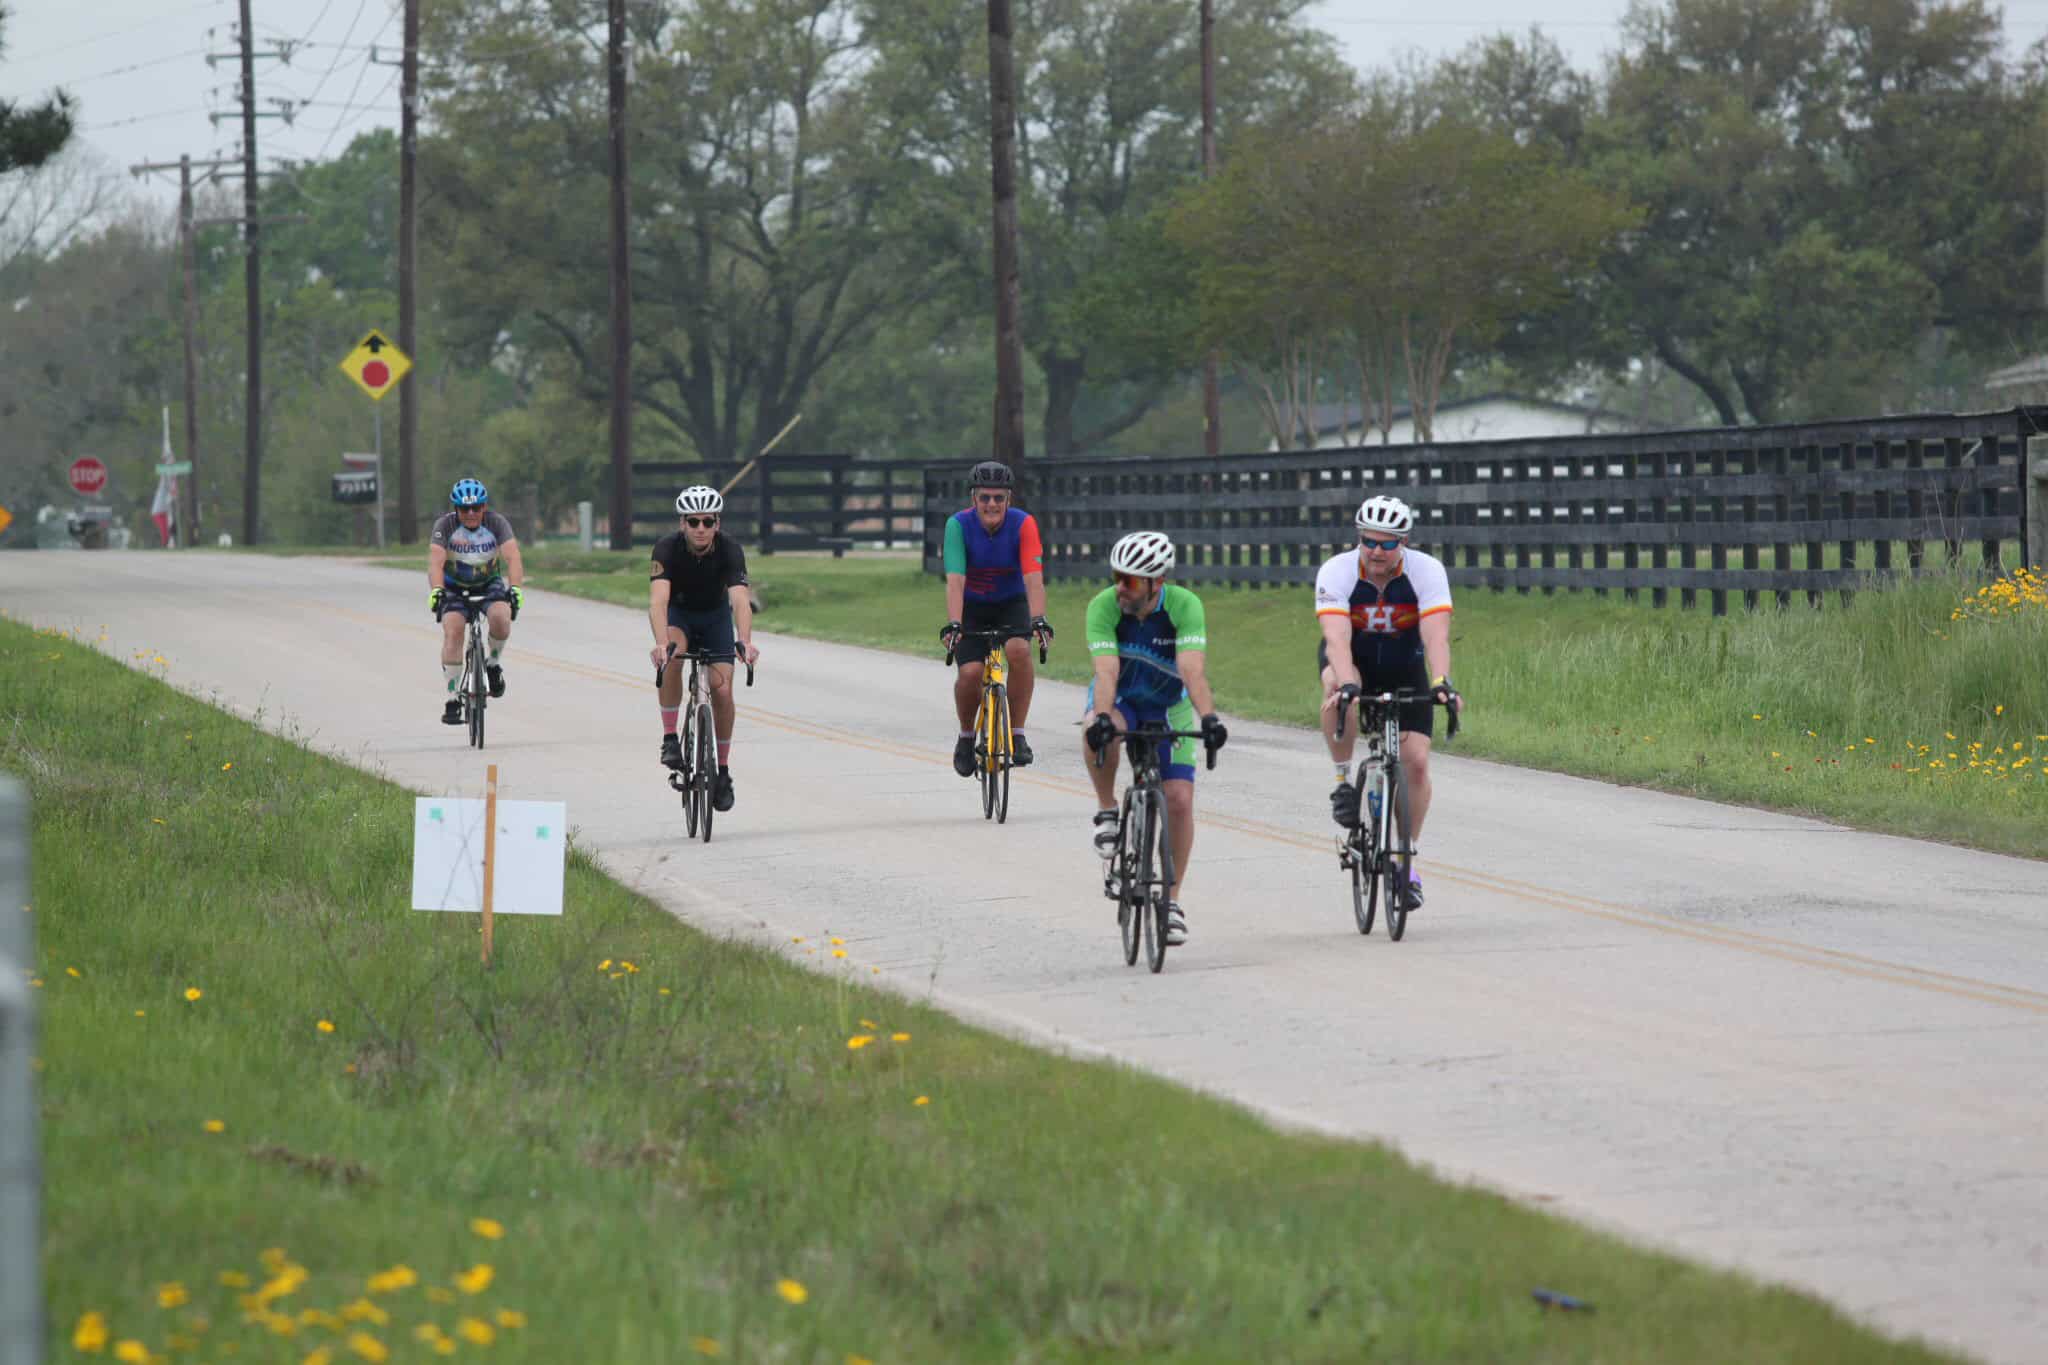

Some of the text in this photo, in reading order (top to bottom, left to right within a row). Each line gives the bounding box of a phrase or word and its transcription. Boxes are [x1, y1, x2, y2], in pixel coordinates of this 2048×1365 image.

[72, 468, 105, 482] STOP
[448, 541, 496, 554] HOUSTON
[1363, 606, 1397, 632] H
